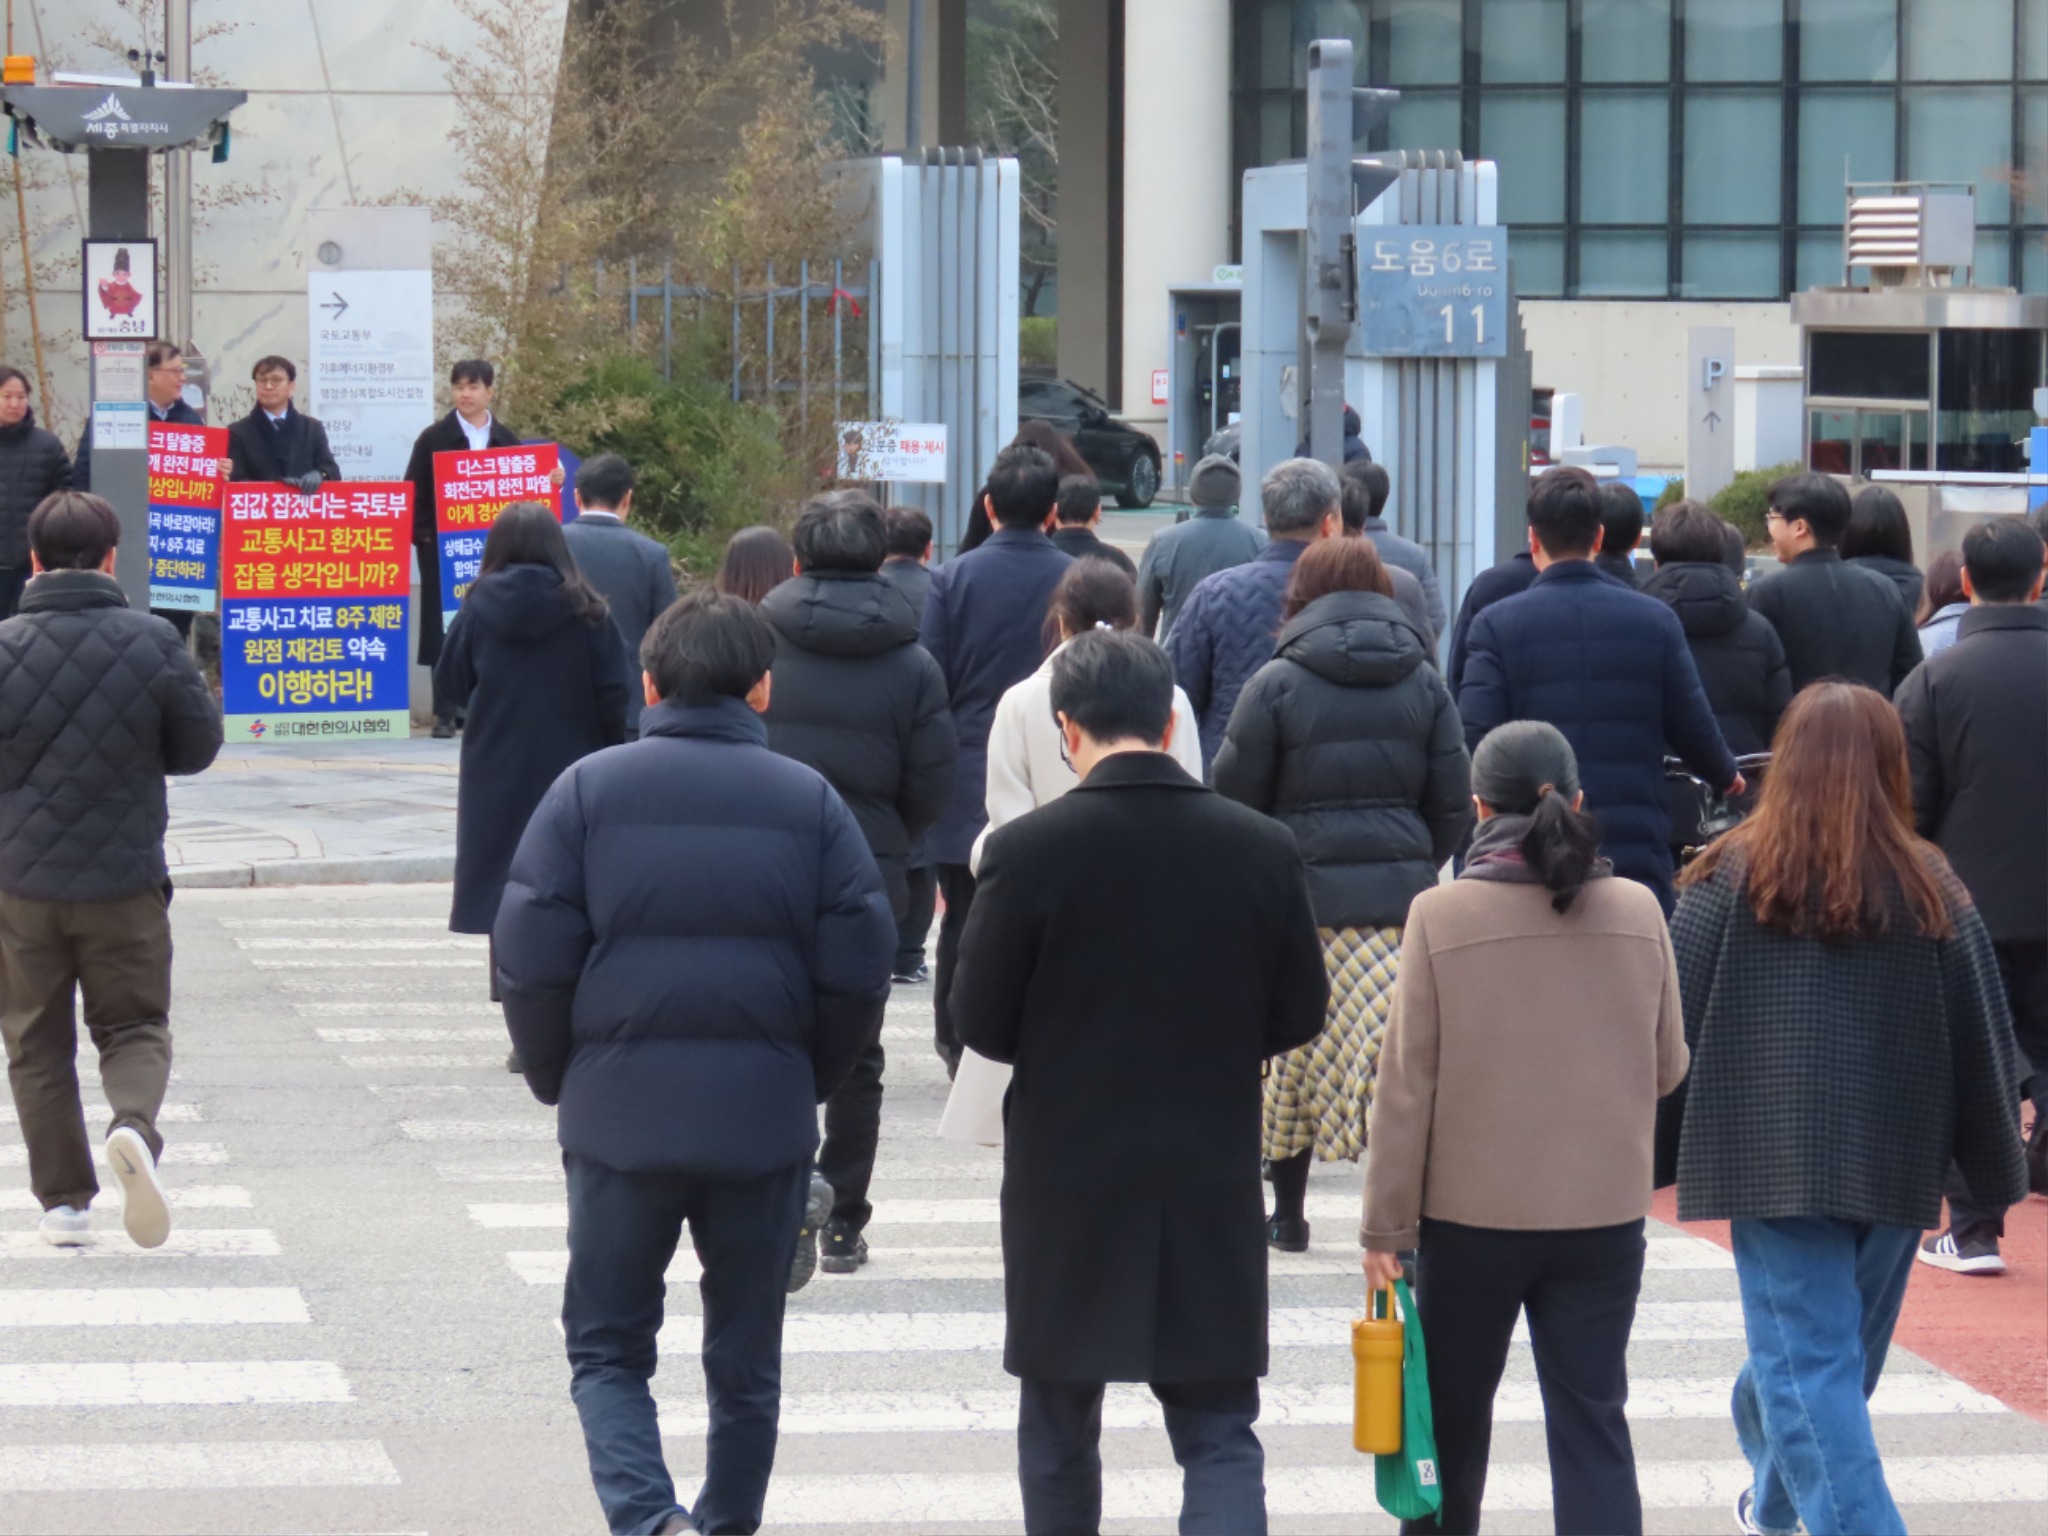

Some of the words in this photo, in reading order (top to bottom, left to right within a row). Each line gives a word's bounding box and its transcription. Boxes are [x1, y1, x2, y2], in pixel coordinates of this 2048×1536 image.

[1370, 239, 1498, 276] 도움6로
[321, 330, 371, 341] 국토교통부
[1440, 304, 1484, 344] 11
[1703, 357, 1726, 389] P
[167, 432, 206, 454] 탈출증
[163, 455, 189, 475] 완전
[191, 457, 218, 477] 파열
[457, 458, 497, 477] 디스크
[498, 455, 536, 475] 탈출증
[444, 478, 496, 500] 회전근개
[498, 476, 523, 497] 완전
[526, 475, 552, 494] 파열
[230, 492, 269, 520] 집값
[271, 492, 347, 520] 잡겠다는
[350, 492, 407, 519] 국토부
[447, 502, 475, 524] 이게
[164, 513, 215, 534] 바로잡아라!
[185, 538, 205, 555] 치료
[240, 527, 326, 555] 교통사고
[330, 526, 394, 554] 환자도
[156, 559, 205, 580] 중단하라!
[233, 563, 277, 590] 잡을
[281, 560, 399, 589] 생각입니까?
[228, 606, 297, 632] 교통사고
[299, 605, 333, 631] 치료
[336, 606, 365, 630] 8주
[368, 604, 402, 629] 제한
[244, 638, 283, 664] 원점
[286, 637, 345, 663] 재검토
[347, 636, 387, 661] 약속
[259, 668, 373, 705] 이행하라!
[292, 719, 390, 736] 대한한의사협회
